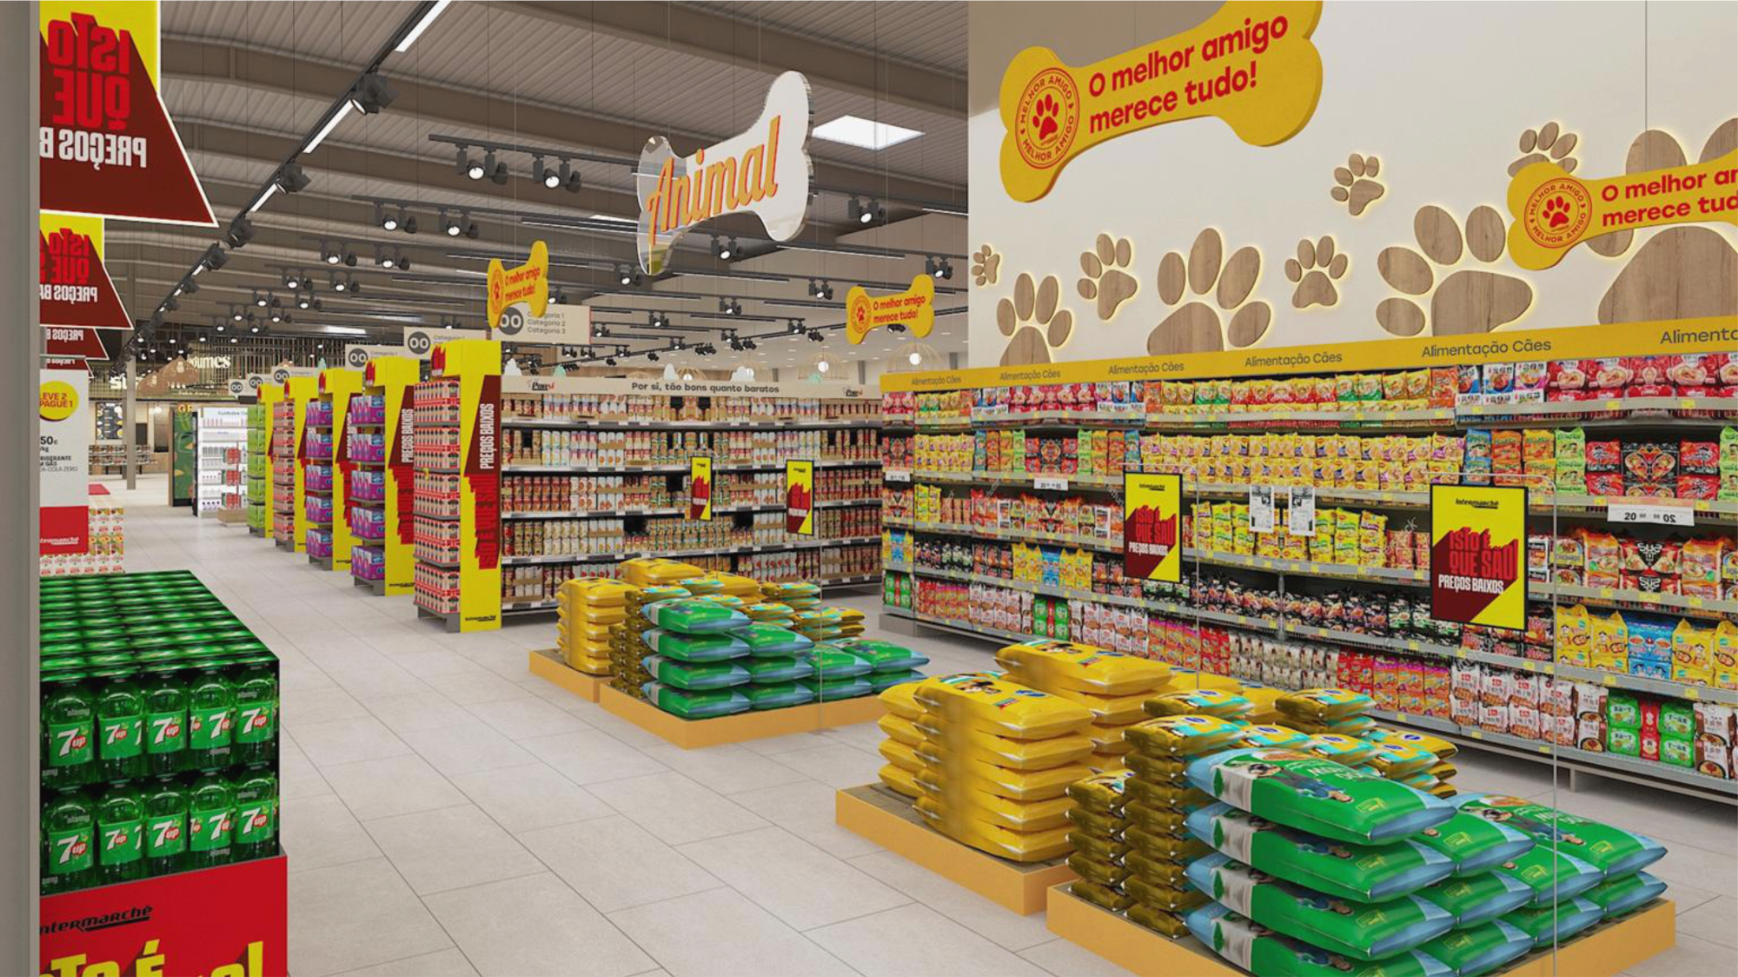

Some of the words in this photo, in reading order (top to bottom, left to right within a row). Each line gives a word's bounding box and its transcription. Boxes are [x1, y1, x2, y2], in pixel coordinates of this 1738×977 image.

[1089, 72, 1105, 97] O
[1111, 45, 1195, 92] melhor
[1201, 15, 1289, 62] amigo
[1020, 78, 1046, 124] MELHOR
[1048, 75, 1072, 99] AMIGO
[1089, 90, 1178, 134] merece
[1184, 60, 1258, 106] tudo!
[1022, 139, 1052, 161] MELHOR
[1055, 116, 1075, 155] AMIGO
[647, 114, 781, 247] Animal
[1602, 185, 1619, 202] O
[1625, 173, 1707, 199] melhor
[1529, 185, 1556, 215] MELHOR
[1559, 183, 1585, 201] AMIGO
[1602, 202, 1691, 227] merece
[1532, 226, 1563, 242] MELHOR
[1566, 212, 1587, 239] AMIGO
[873, 301, 879, 310] O
[880, 298, 902, 308] melhor
[904, 294, 926, 307] amigo
[873, 312, 899, 323] merece
[900, 308, 919, 320] tudo!
[1245, 353, 1311, 369] Alimentação
[1313, 351, 1343, 364] Cães
[1422, 341, 1508, 359] Alimentação
[1512, 338, 1552, 353] Cães
[1000, 371, 1041, 382] Alimentação
[1042, 369, 1061, 379] Cães
[1108, 362, 1160, 375] Alimentação
[1161, 361, 1184, 372] Cães
[631, 382, 648, 391] Por
[664, 383, 682, 391] tão
[684, 383, 707, 392] bons
[709, 385, 742, 394] quanto
[743, 385, 780, 393] baratos
[911, 376, 945, 387] Alimentação
[1624, 512, 1637, 521] 20
[1450, 550, 1478, 577] QUE
[1438, 574, 1471, 592] PREÇOS
[1472, 577, 1504, 594] BAIXOS
